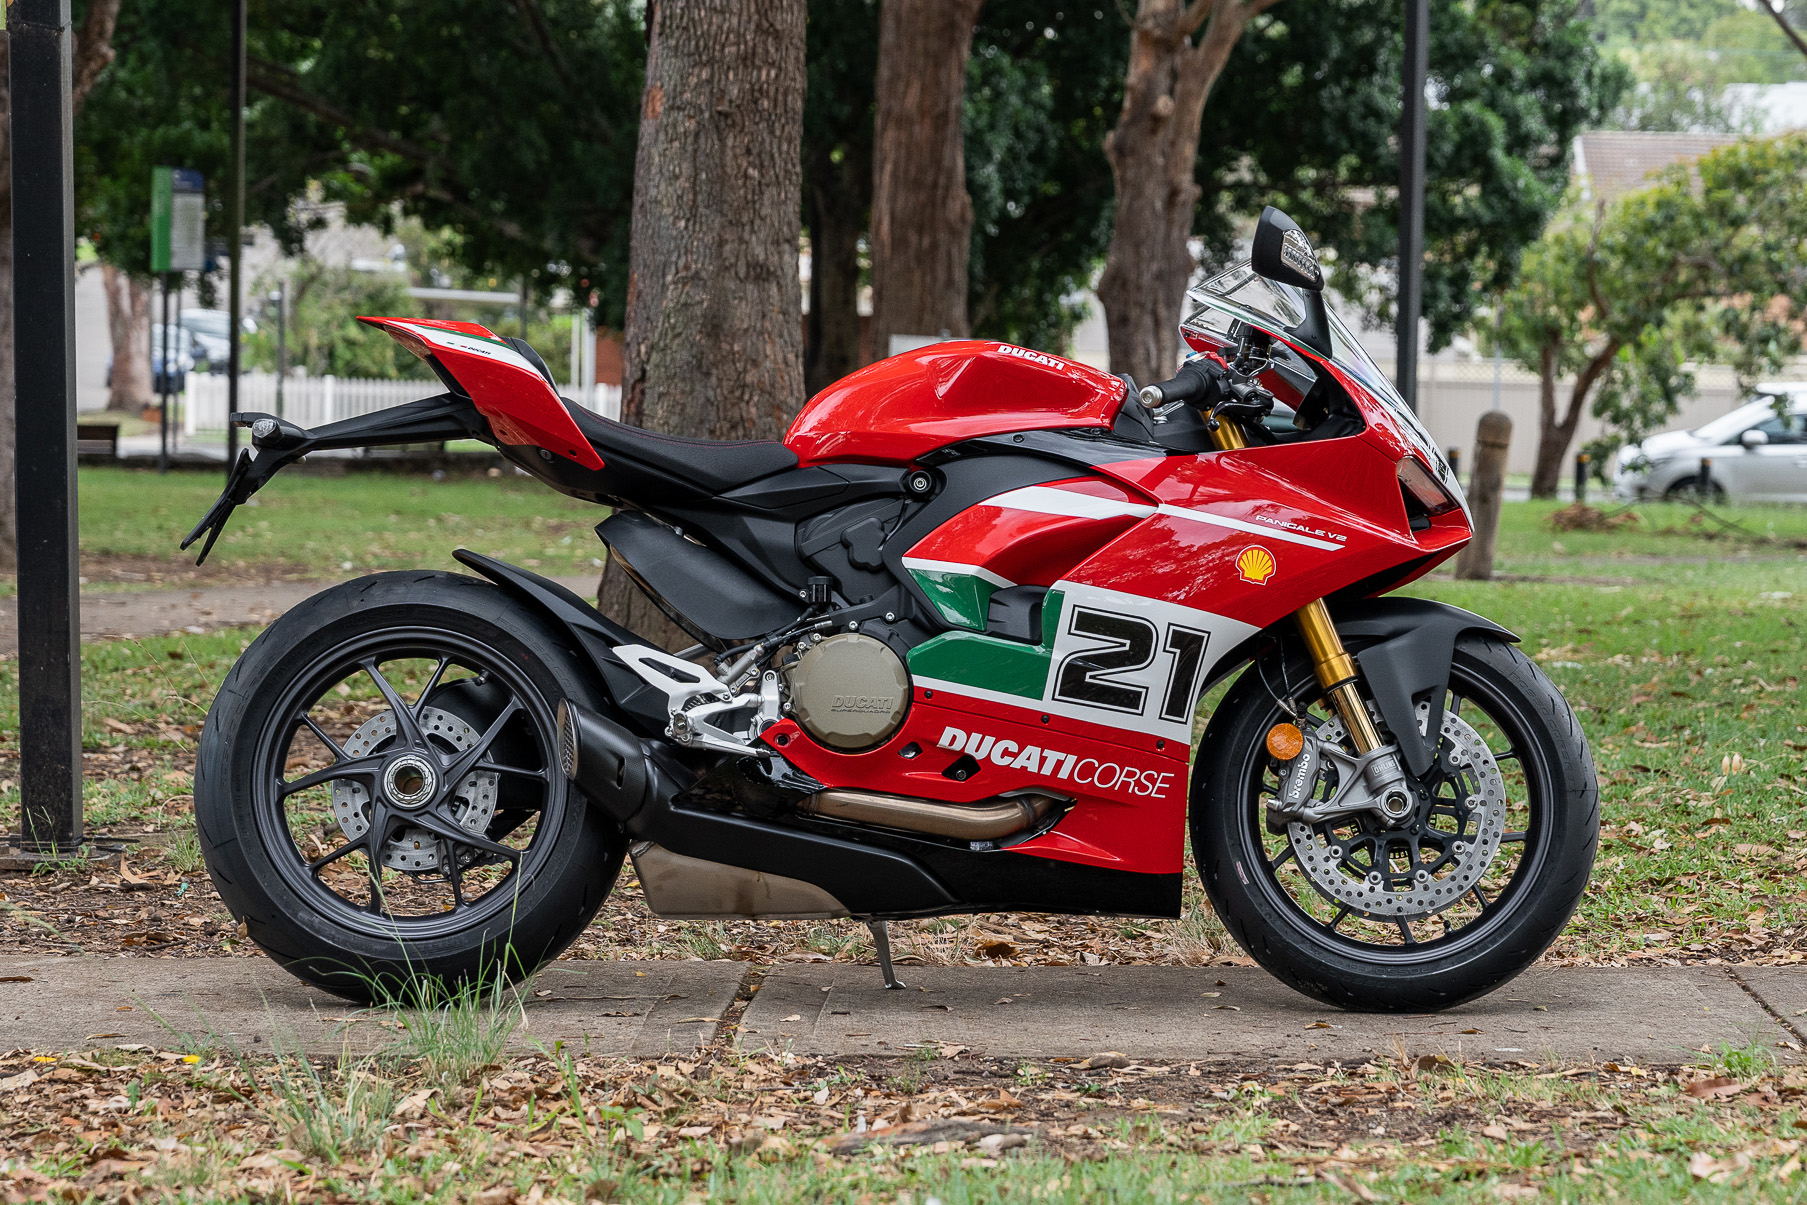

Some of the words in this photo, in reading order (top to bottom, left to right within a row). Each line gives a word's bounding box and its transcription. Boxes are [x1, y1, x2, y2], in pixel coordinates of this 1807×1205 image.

[997, 345, 1065, 371] DUCATI
[1255, 515, 1326, 537] PANIGALE
[1327, 531, 1348, 542] V2
[1051, 604, 1211, 725] 21
[831, 695, 894, 710] DUCATI
[936, 726, 1078, 780] DUCATI
[1073, 758, 1175, 799] CORSE
[1288, 753, 1311, 799] brembo
